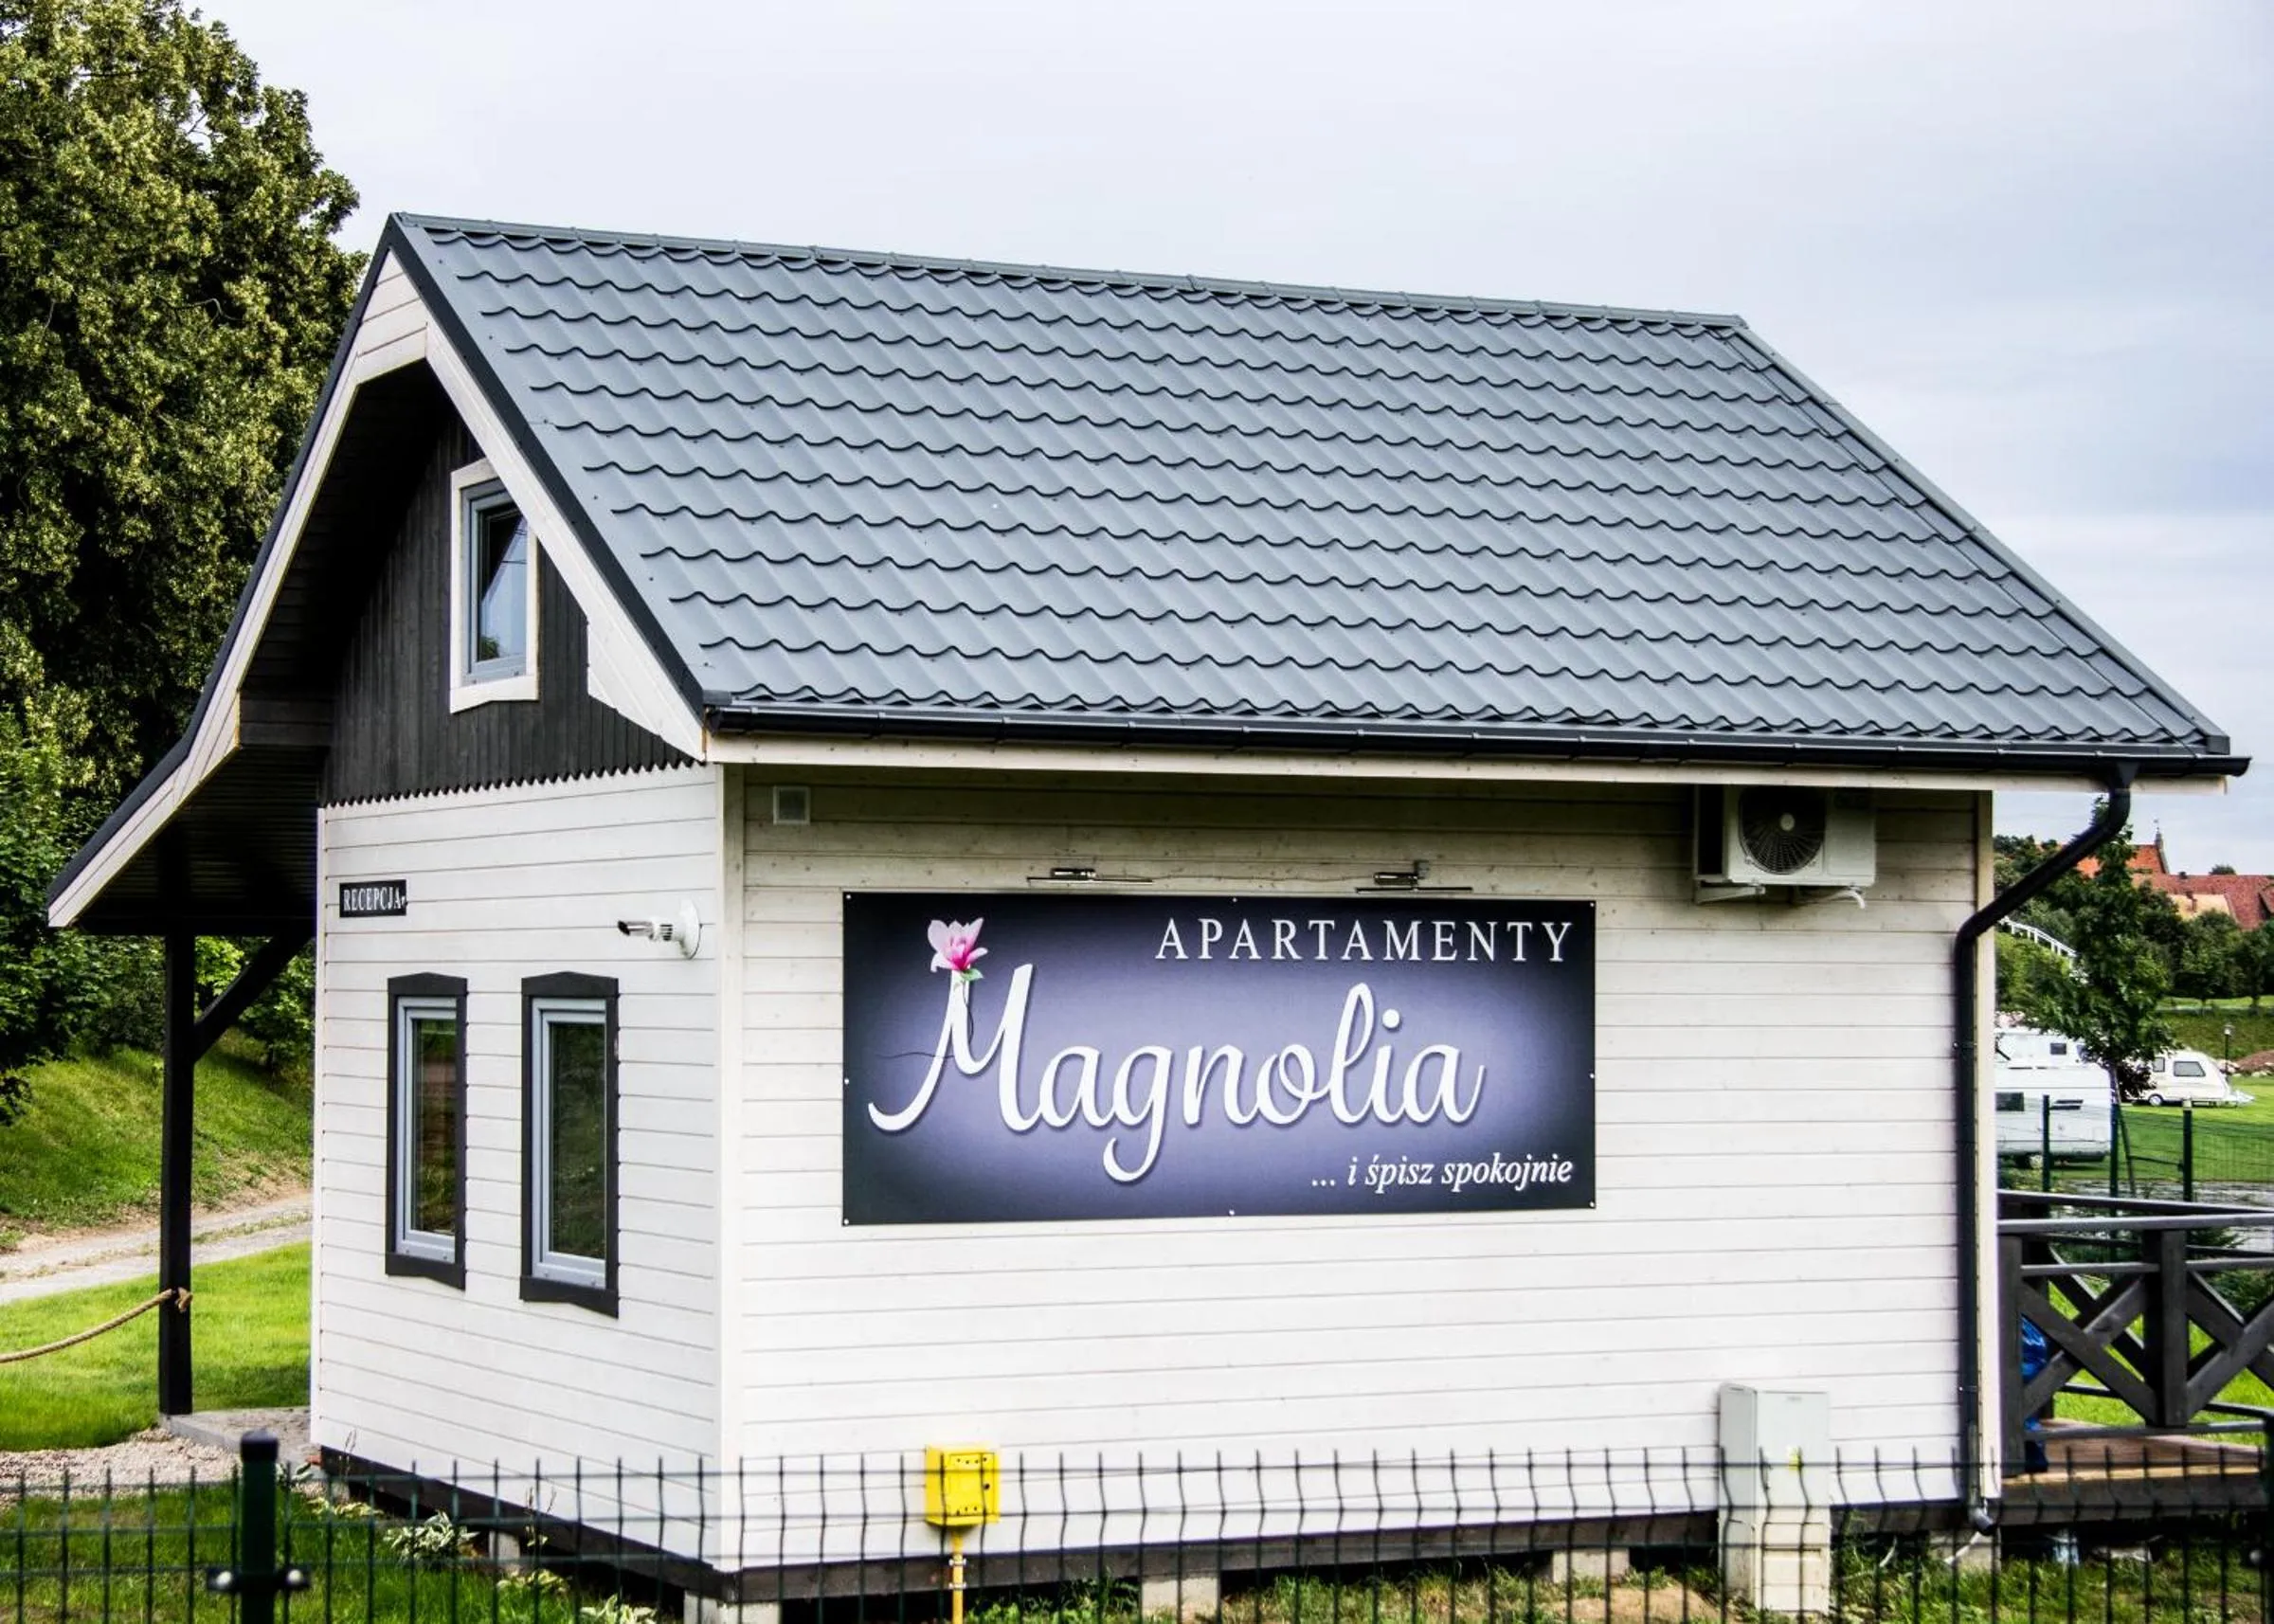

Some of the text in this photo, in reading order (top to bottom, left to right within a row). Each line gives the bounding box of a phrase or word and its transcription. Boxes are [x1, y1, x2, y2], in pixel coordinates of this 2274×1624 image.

[343, 886, 402, 911] RECEPCJA
[1155, 918, 1573, 962] APARTAMENTY
[868, 963, 1486, 1182] Magnolia
[1347, 1156, 1359, 1185] i
[1364, 1154, 1435, 1194] śpisz
[1441, 1152, 1573, 1192] spokojnie
